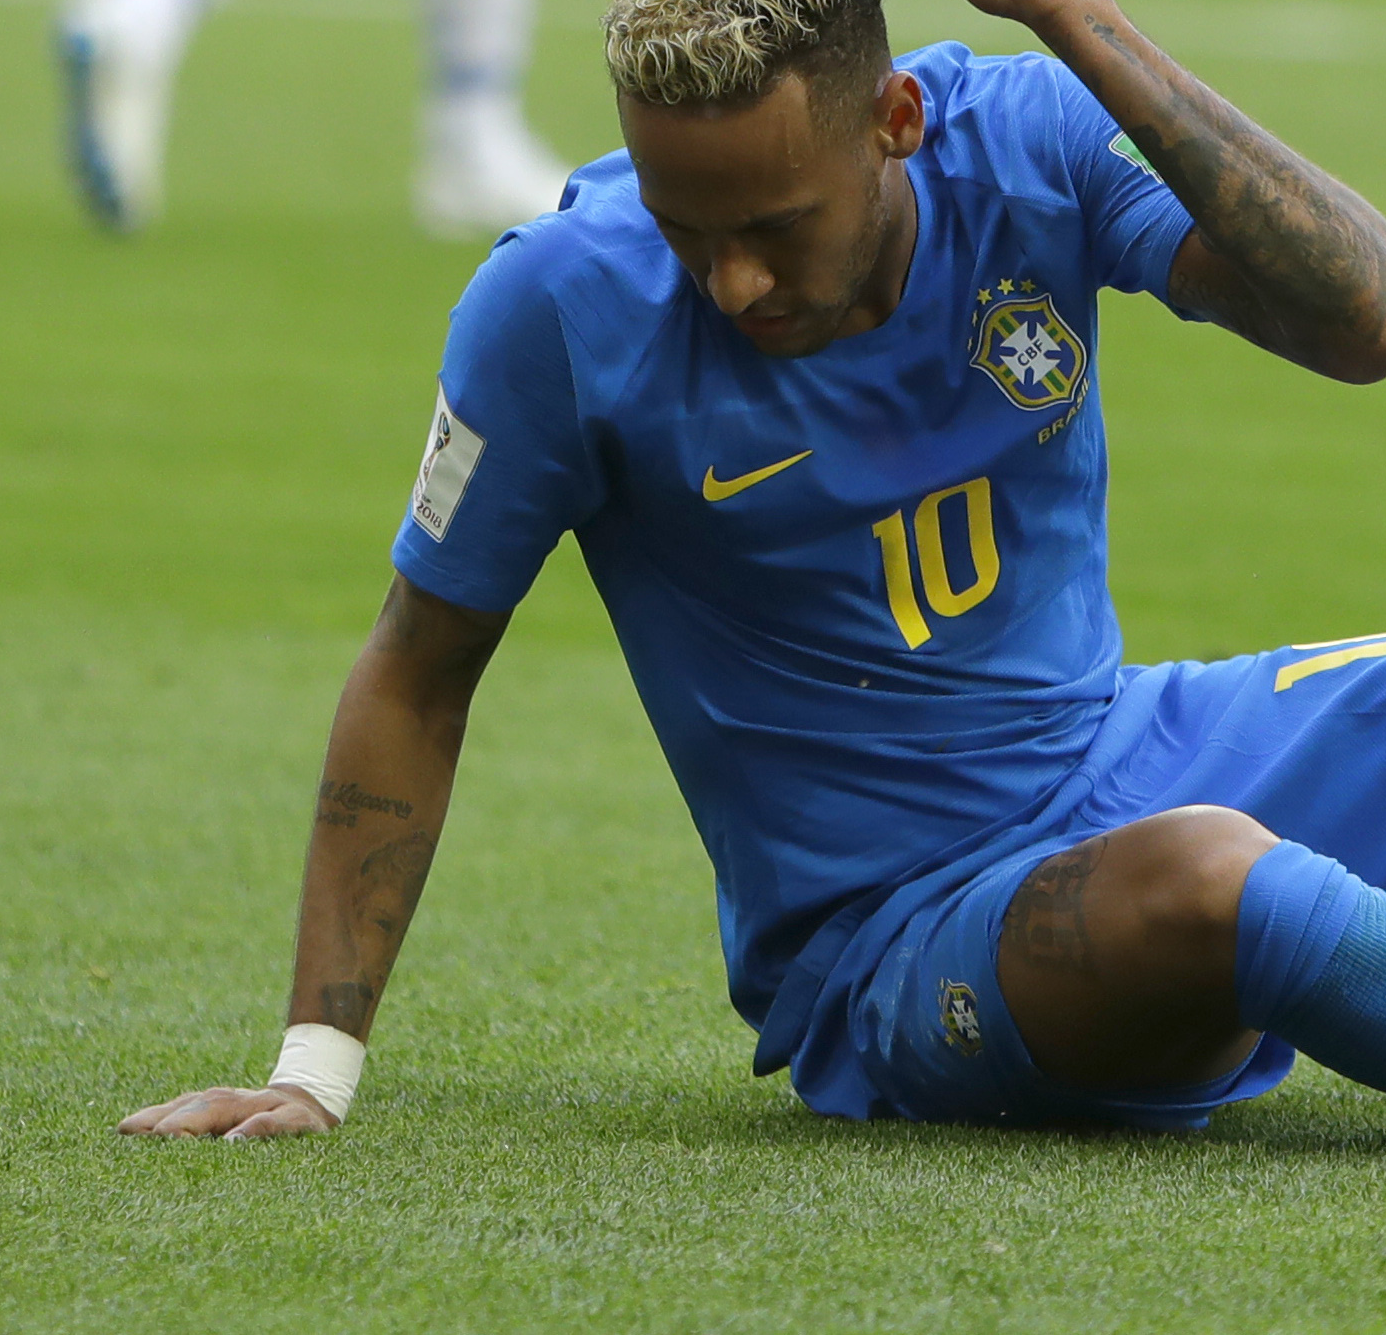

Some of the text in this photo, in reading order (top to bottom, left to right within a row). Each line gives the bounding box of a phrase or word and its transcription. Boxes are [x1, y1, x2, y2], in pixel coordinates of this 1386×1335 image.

[1017, 338, 1045, 367] CBF
[1037, 377, 1090, 445] BRASIL
[416, 501, 442, 528] 2018
[872, 476, 1001, 651] 10
